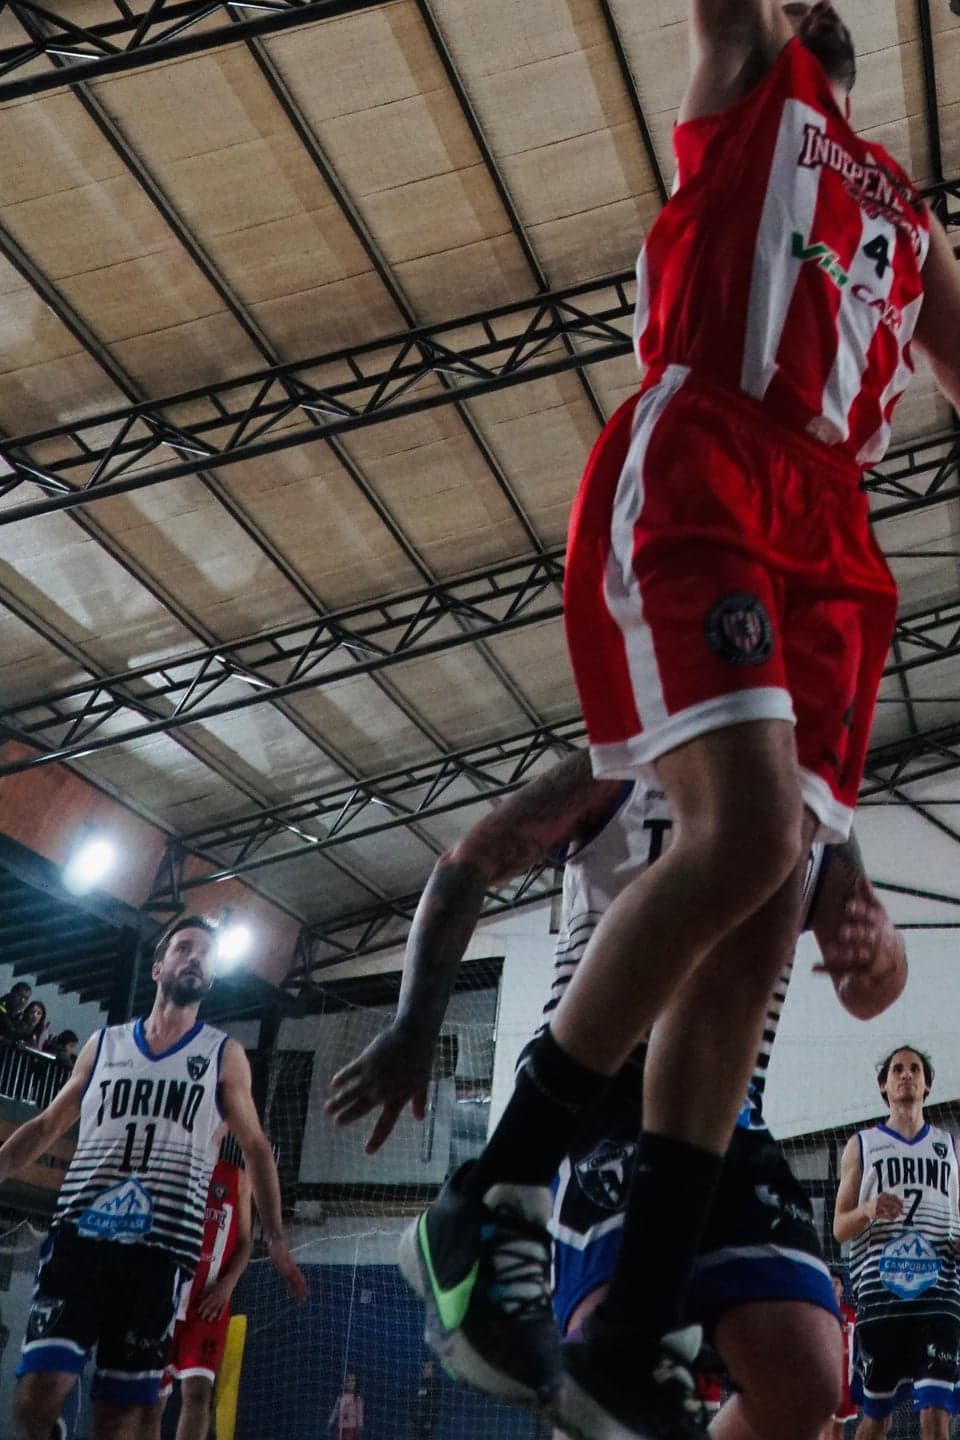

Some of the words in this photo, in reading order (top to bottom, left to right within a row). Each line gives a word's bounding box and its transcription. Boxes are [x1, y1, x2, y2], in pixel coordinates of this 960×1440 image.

[863, 235, 889, 278] 4
[97, 1078, 205, 1133] TORINO
[118, 1122, 156, 1173] 11
[872, 1157, 951, 1197] TORINO
[903, 1188, 923, 1227] 7
